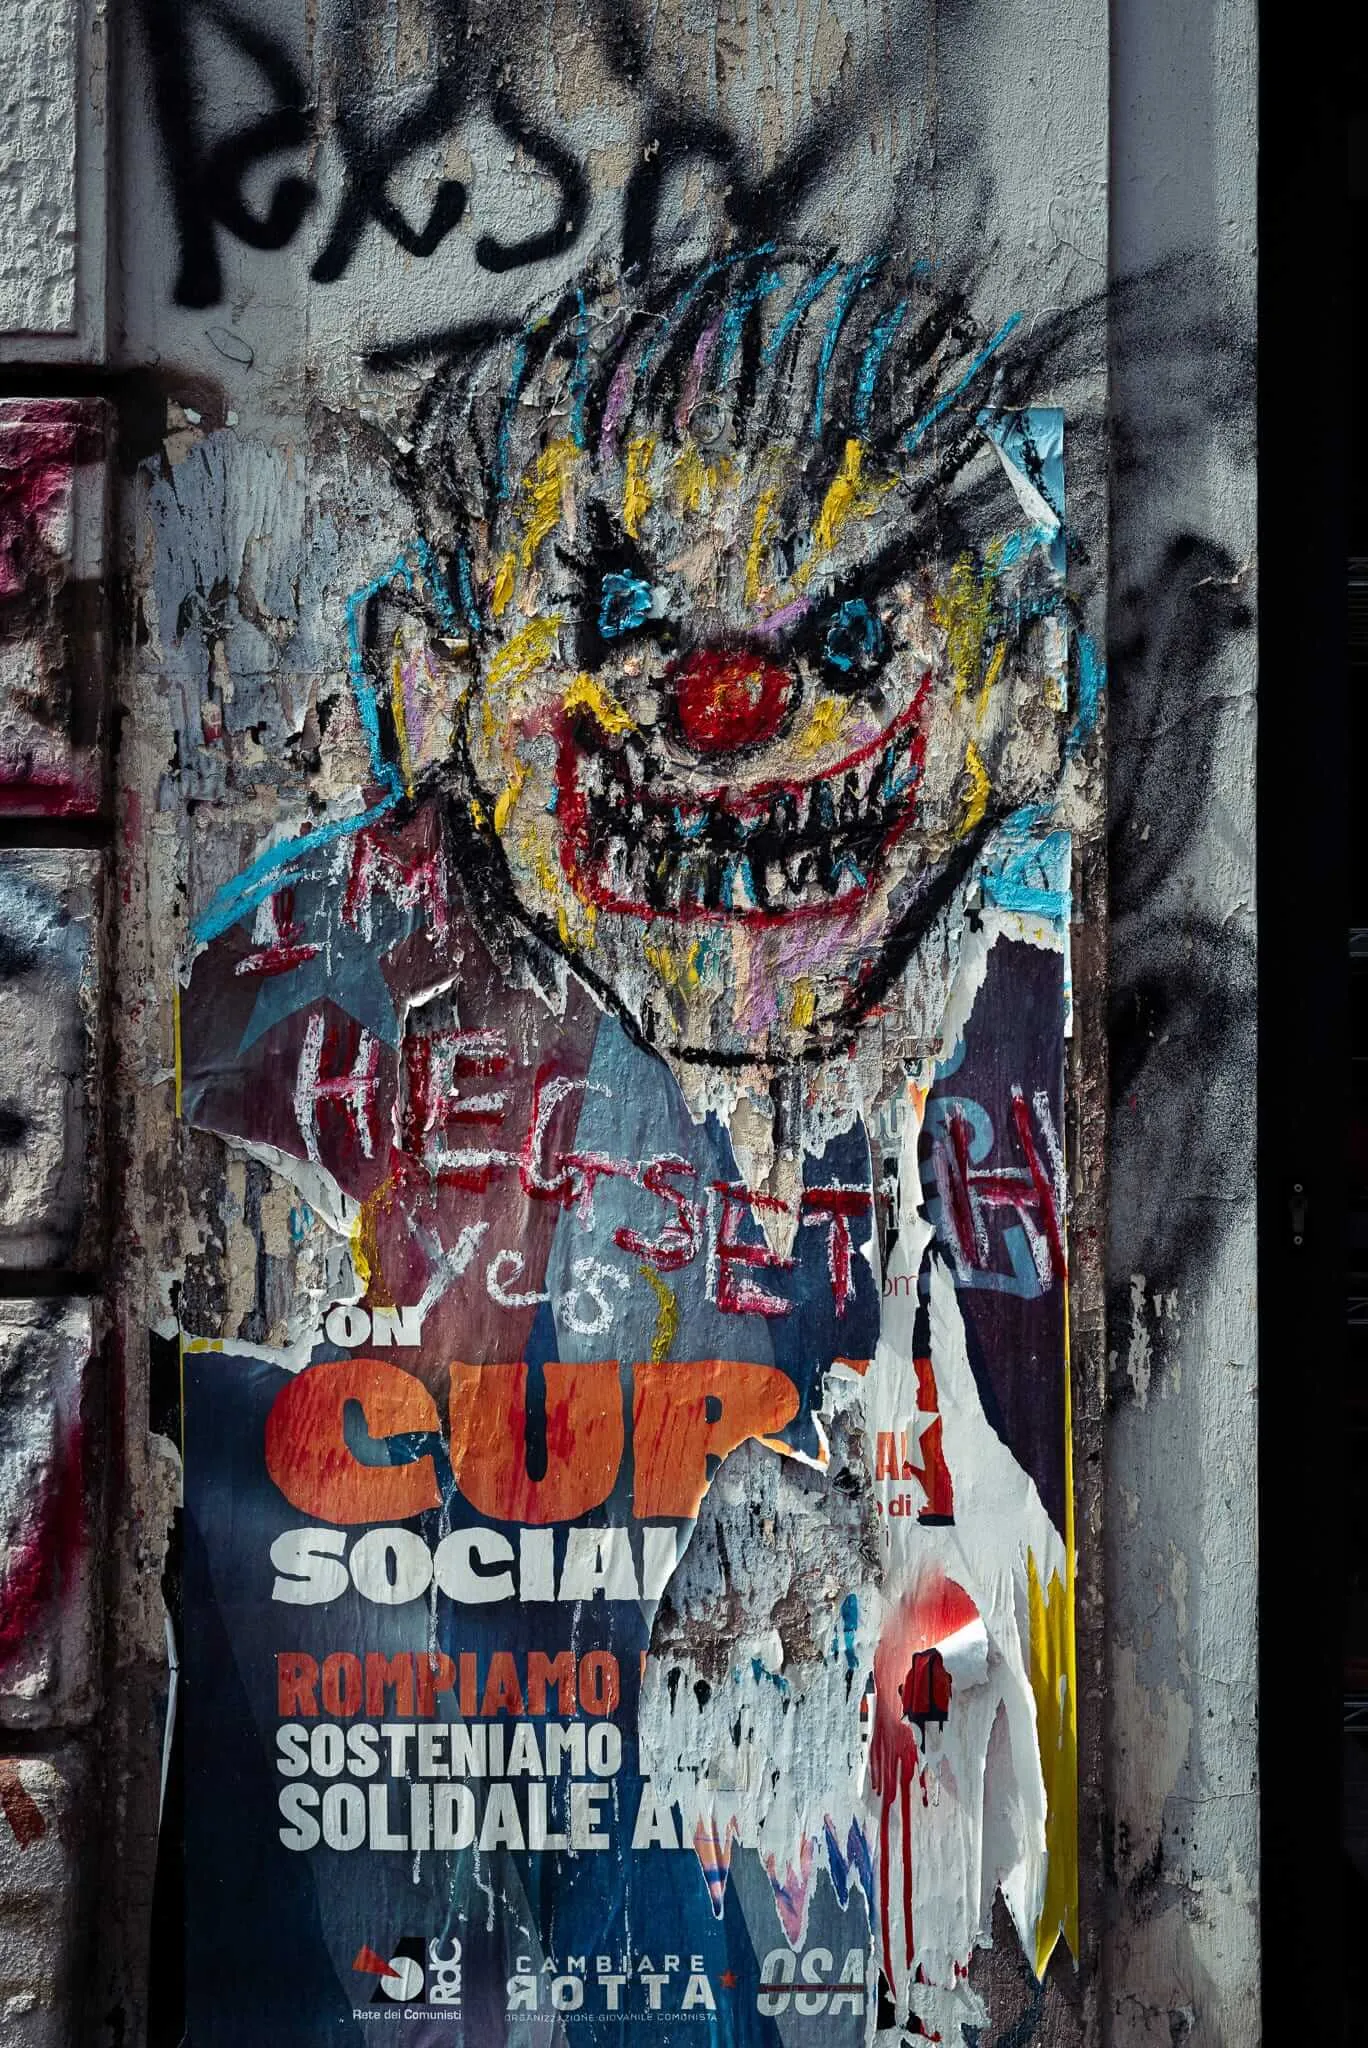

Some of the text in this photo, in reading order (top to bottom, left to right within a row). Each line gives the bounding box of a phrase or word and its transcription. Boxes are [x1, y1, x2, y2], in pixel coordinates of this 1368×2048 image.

[276, 1651, 621, 1717] ROMPIAMO
[275, 1722, 623, 1778] SOSTENIAMO
[278, 1782, 610, 1851] SOLIDALE
[515, 1954, 705, 1973] CAMBIARE
[756, 1947, 865, 2017] OSA
[352, 2008, 462, 2020] Rete dei Comunisti
